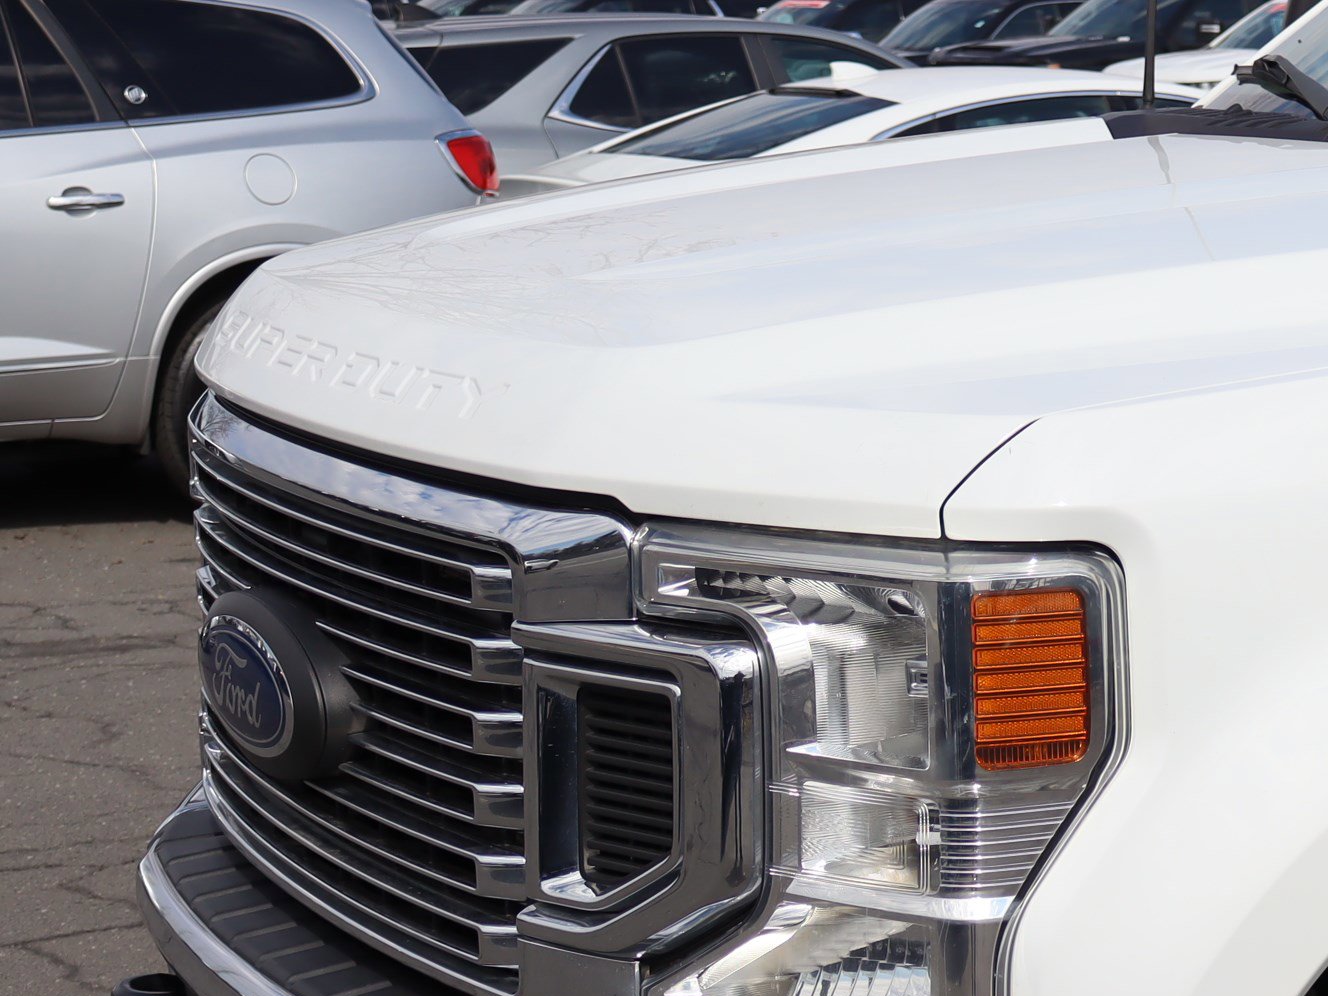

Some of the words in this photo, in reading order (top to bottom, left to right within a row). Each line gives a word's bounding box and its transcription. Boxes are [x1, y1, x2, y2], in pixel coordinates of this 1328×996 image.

[215, 310, 338, 382] SUPER
[330, 351, 511, 420] DUTY
[212, 642, 262, 728] Ford
